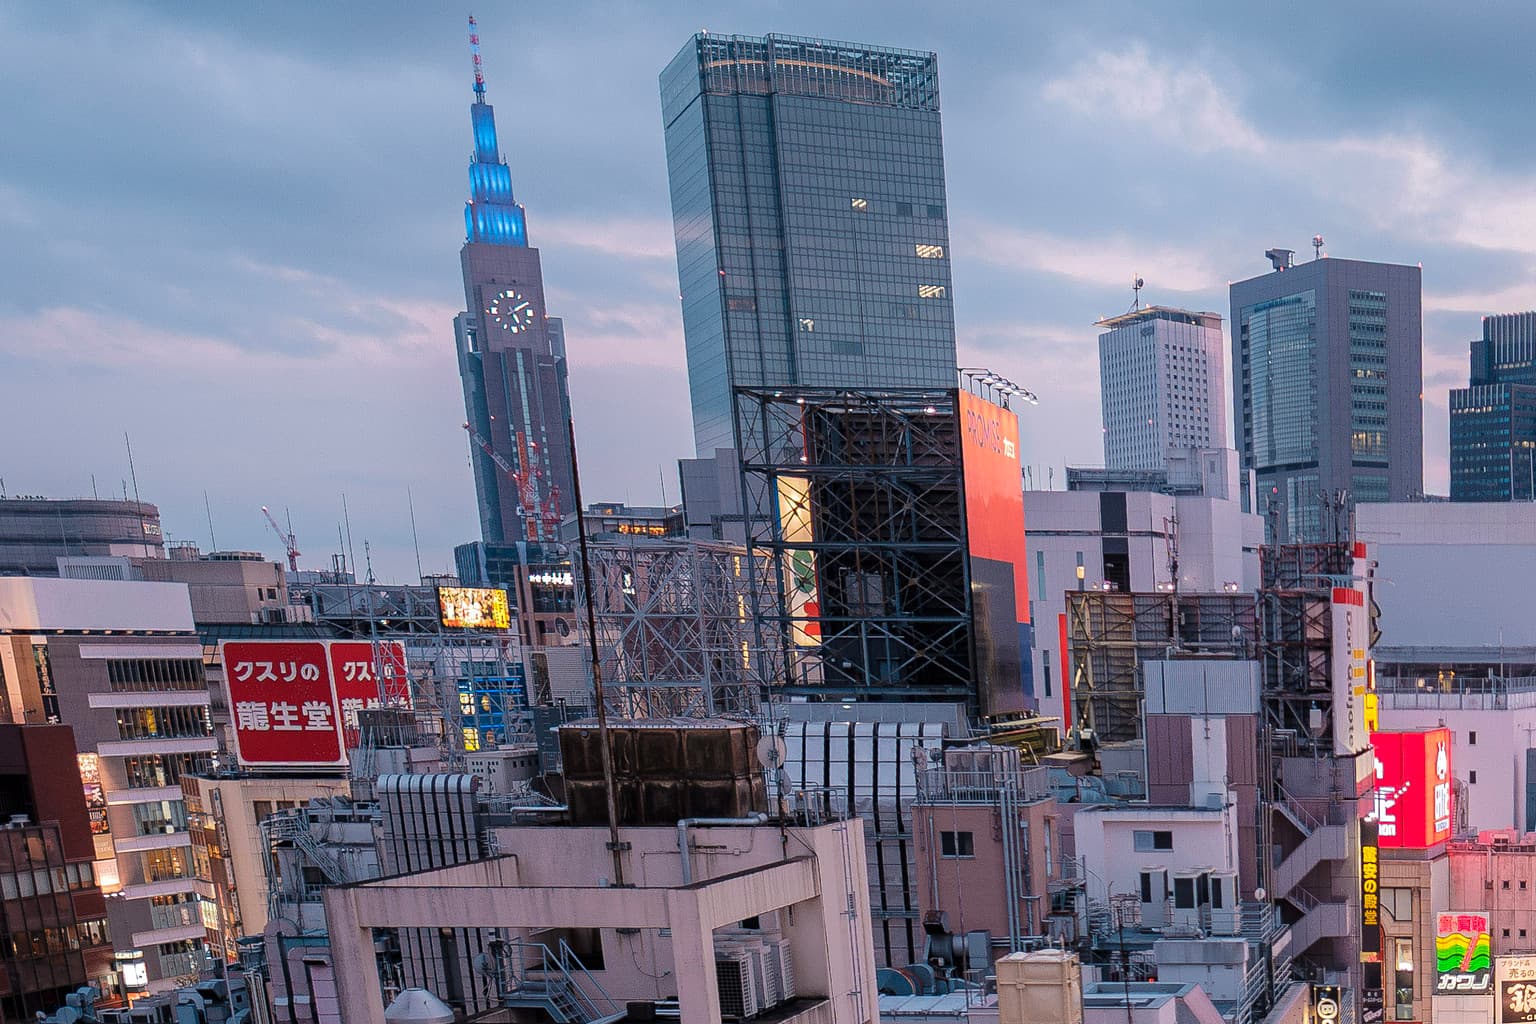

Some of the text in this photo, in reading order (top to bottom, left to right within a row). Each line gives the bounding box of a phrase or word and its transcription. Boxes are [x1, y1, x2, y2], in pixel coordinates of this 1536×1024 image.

[233, 661, 320, 682] クスリの
[235, 700, 334, 731] 龍生堂
